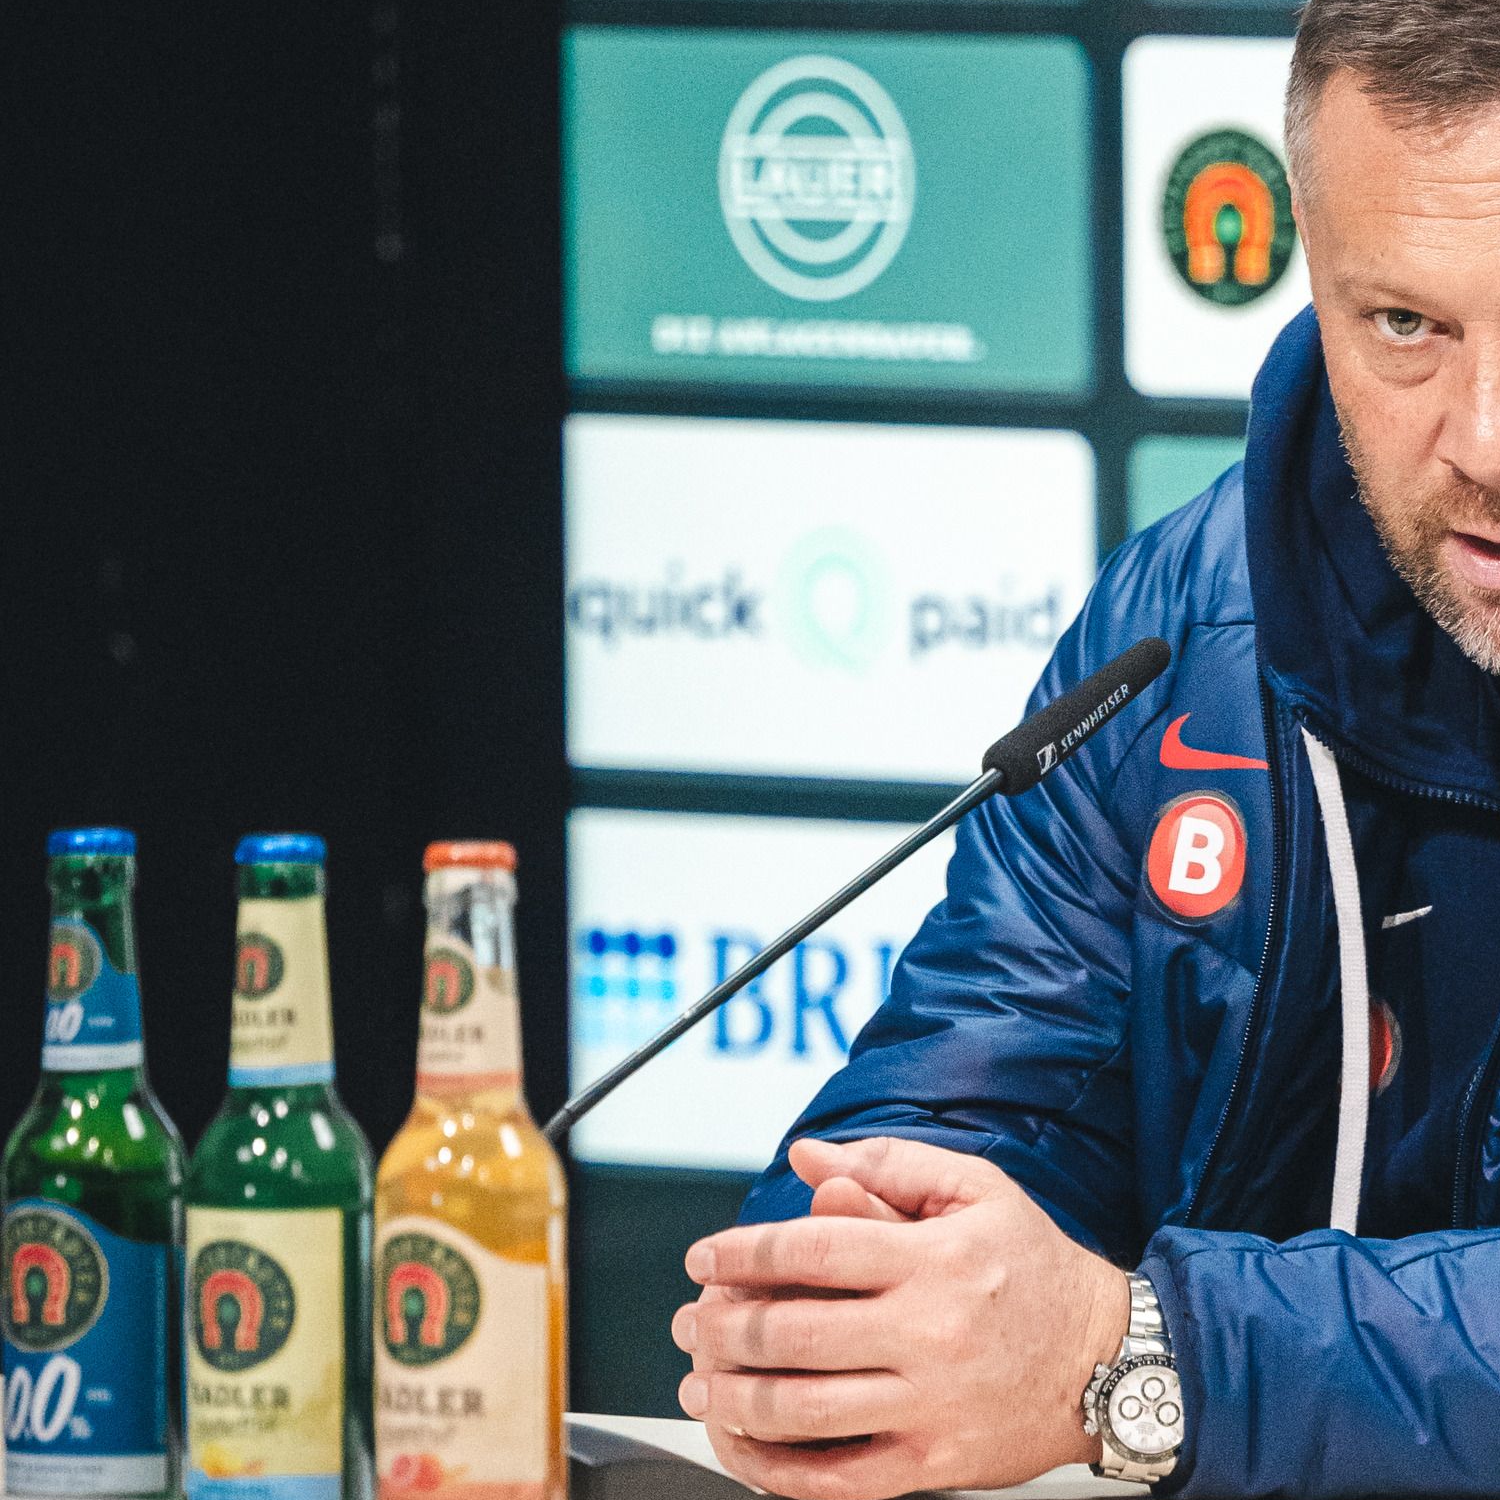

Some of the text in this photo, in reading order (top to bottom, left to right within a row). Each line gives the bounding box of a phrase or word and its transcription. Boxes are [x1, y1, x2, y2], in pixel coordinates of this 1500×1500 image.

[567, 558, 1063, 658] quick paid
[1061, 683, 1130, 754] SENNHEISER
[1168, 815, 1226, 896] B
[712, 933, 897, 1056] BRI
